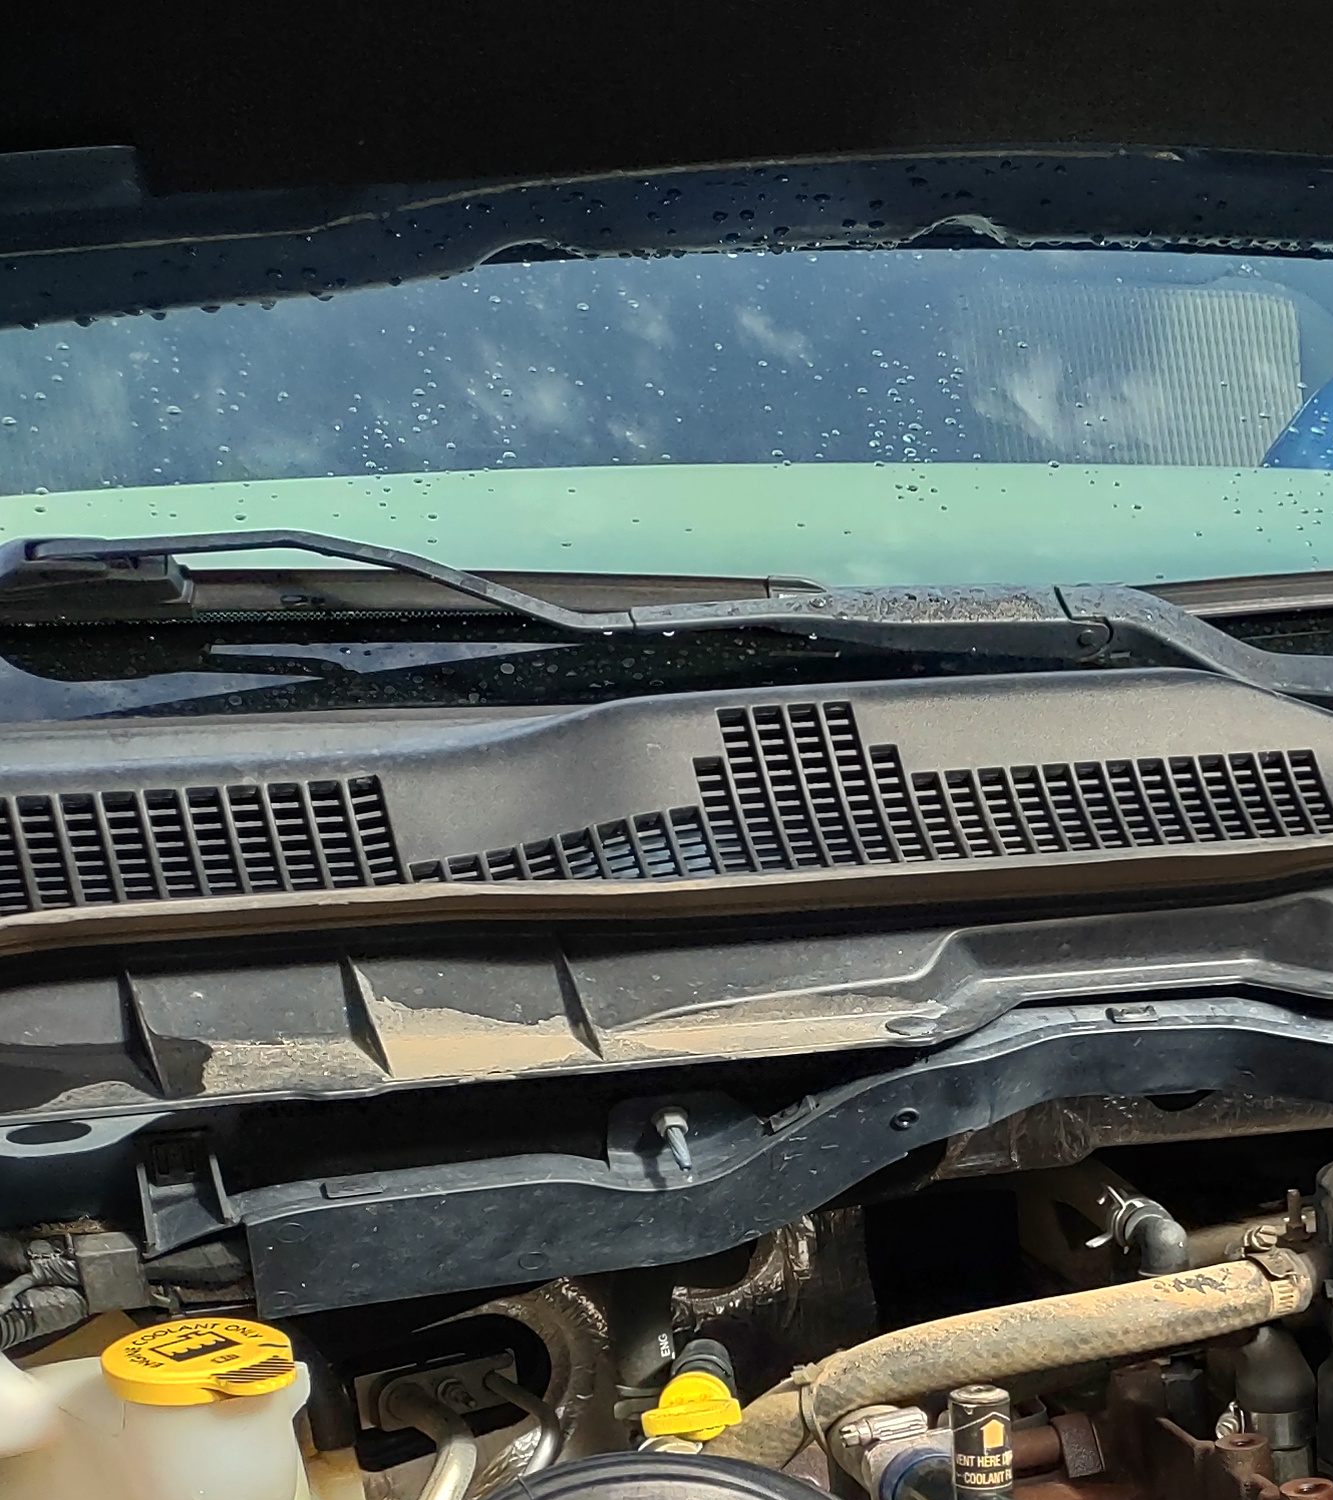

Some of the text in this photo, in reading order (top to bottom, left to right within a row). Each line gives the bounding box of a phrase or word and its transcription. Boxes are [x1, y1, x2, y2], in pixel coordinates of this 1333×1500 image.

[132, 1323, 220, 1346] COOLANT
[224, 1324, 263, 1340] ONLY
[658, 1333, 671, 1358] ENG
[977, 1454, 1002, 1468] HERE
[964, 1471, 1005, 1485] COOLANT
